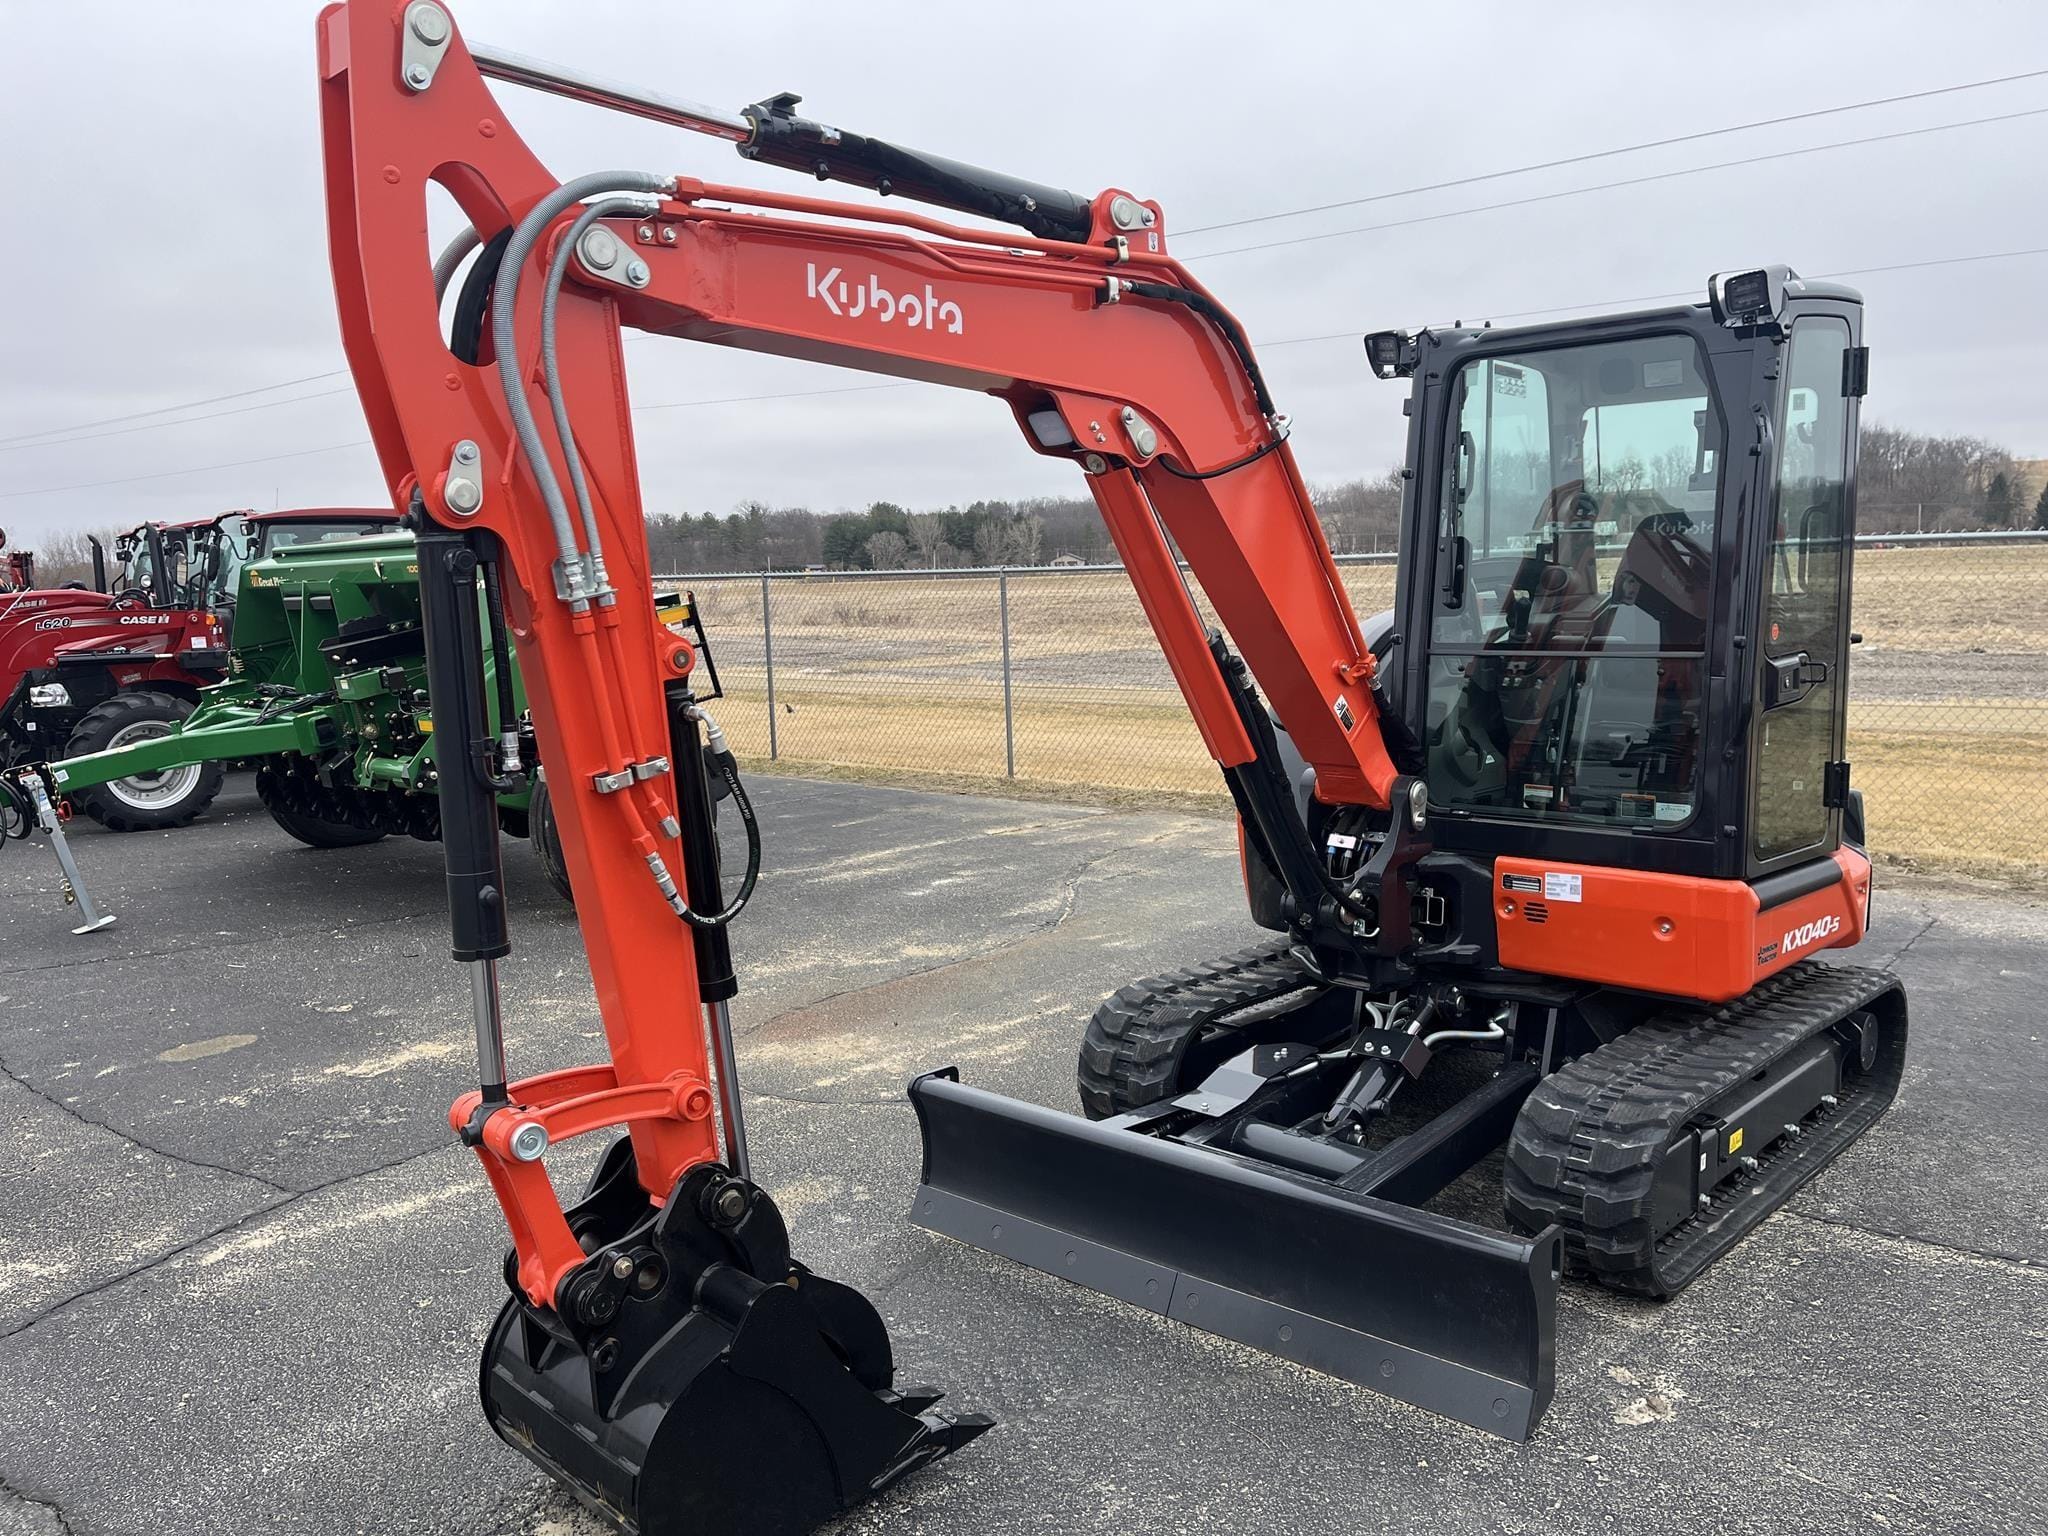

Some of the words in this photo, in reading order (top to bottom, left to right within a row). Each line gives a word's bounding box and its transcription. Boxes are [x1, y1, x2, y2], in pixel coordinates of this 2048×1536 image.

[807, 262, 963, 335] Kubota
[35, 616, 72, 631] L620
[120, 616, 156, 625] CASE
[1781, 915, 1841, 954] KX040-5
